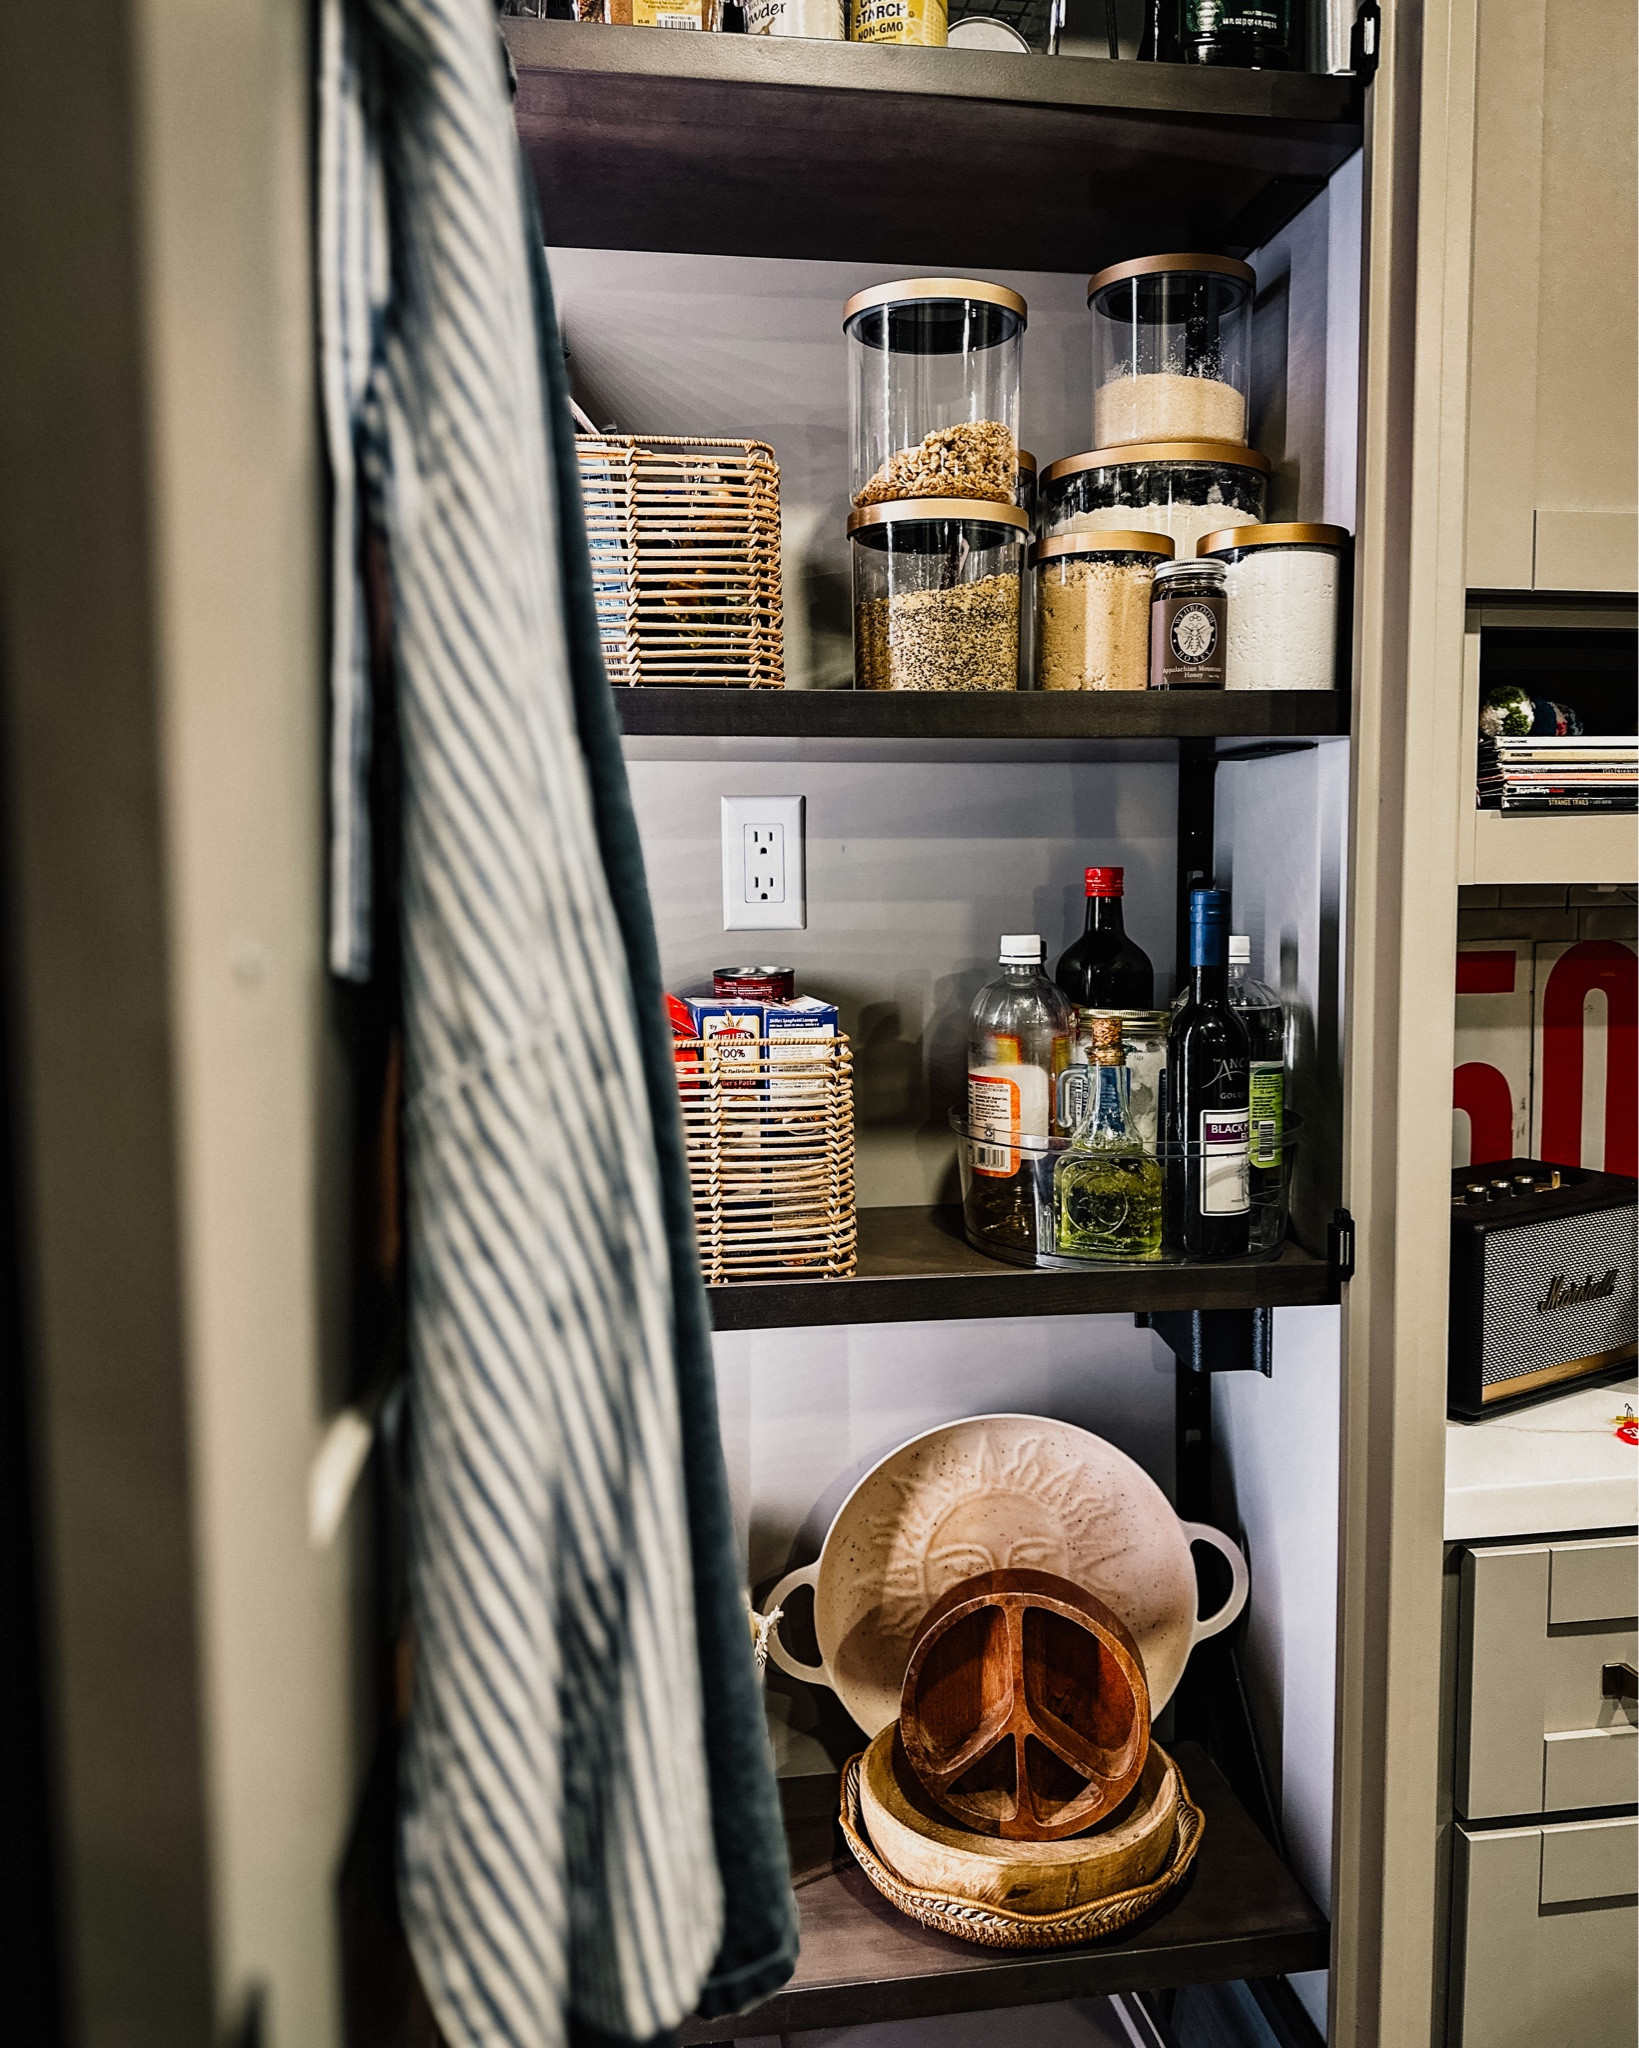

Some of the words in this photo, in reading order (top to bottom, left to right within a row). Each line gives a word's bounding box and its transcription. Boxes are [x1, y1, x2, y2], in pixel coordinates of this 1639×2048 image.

[748, 2, 786, 24] wder
[858, 21, 903, 41] NON-GMO
[1174, 604, 1214, 624] WEHRLOOM
[1177, 650, 1210, 662] HONEY
[1162, 665, 1197, 675] Appalachian
[1184, 671, 1204, 679] Honey
[712, 1031, 751, 1040] MUELLER'S
[1201, 1057, 1248, 1089] ANC
[1211, 1122, 1243, 1134] BLACK
[1539, 1269, 1620, 1313] Marshall
